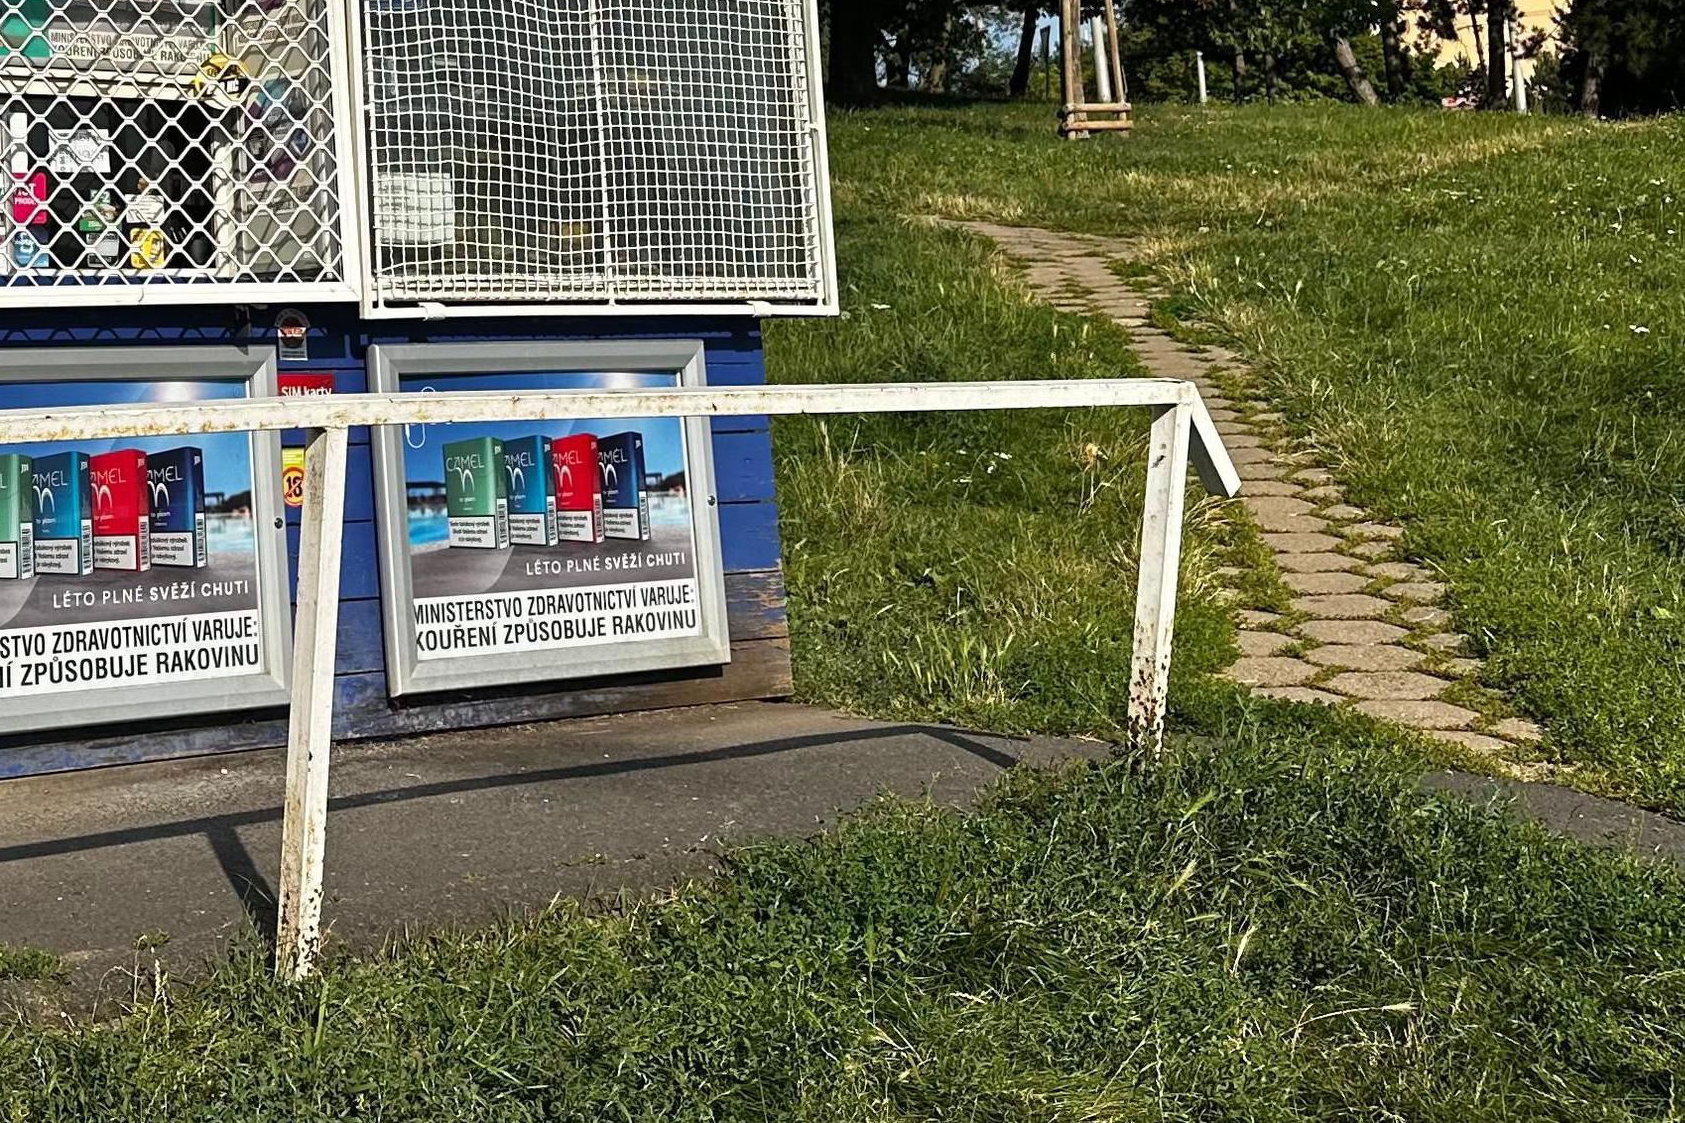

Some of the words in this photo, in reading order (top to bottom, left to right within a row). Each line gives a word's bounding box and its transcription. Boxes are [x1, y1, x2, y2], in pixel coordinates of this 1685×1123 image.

[446, 453, 485, 472] CAMEL
[526, 560, 561, 575] LÉTO
[567, 556, 601, 572] PLNÉ
[604, 553, 642, 570] SVĚŽÍ
[646, 552, 686, 567] CHUTI
[53, 590, 95, 608] LÉTO
[102, 587, 144, 605] PLNÉ
[149, 581, 195, 601] SVĚŽÍ
[201, 580, 249, 596] CHUTI
[414, 597, 522, 624] MINISTERSTVO
[527, 587, 637, 616] ZDRAVOTNICTVÍ
[641, 585, 694, 607] VARUJE:
[52, 617, 187, 655] ZDRAVOTNICTVÍ
[193, 615, 258, 641] VARUJE:
[415, 619, 497, 651] KOUŘENÍ
[504, 617, 606, 643] ZPŮSOBUJE
[613, 609, 696, 635] RAKOVINU
[21, 650, 149, 687] ZPŮSOBUJE
[156, 644, 259, 673] RAKOVINU
